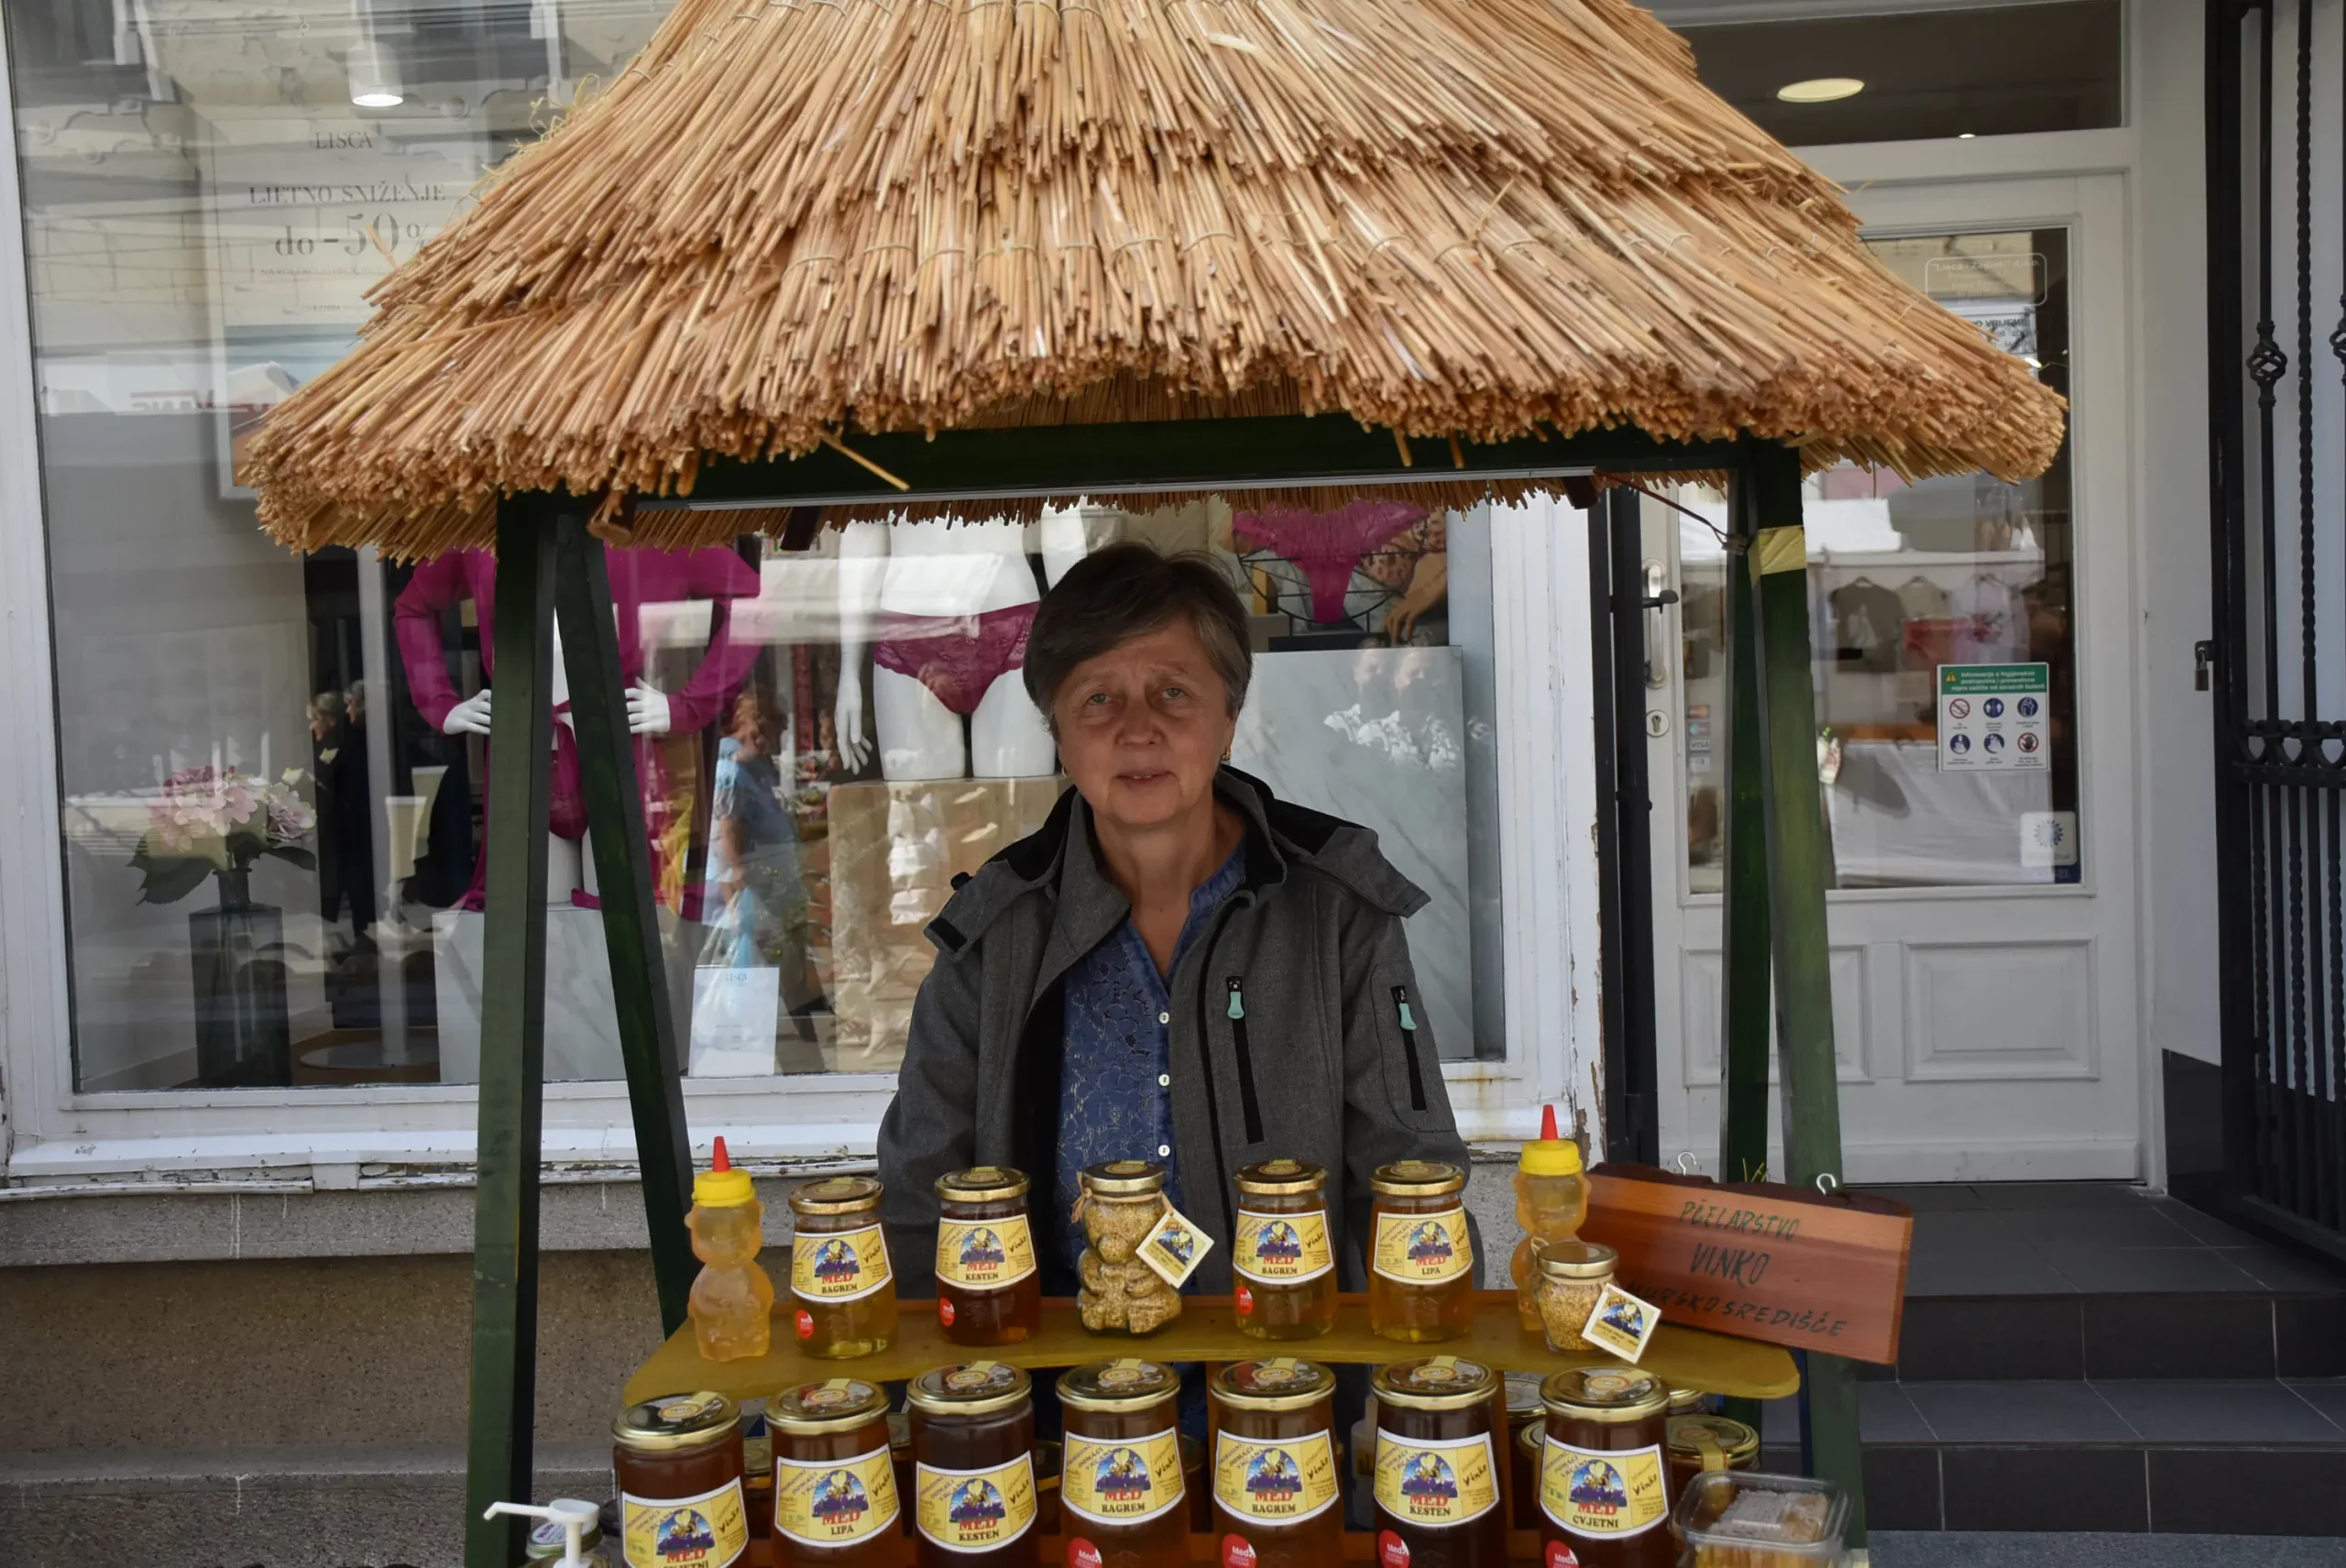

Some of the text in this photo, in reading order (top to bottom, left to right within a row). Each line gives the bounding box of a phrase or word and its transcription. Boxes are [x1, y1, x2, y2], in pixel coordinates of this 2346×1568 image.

[314, 131, 374, 149] LISCA
[248, 181, 446, 204] LJETNO SNIŽENJE
[275, 225, 314, 256] do
[1678, 1199, 1803, 1240] PČELARSTVO
[967, 1260, 998, 1271] MED
[1264, 1254, 1294, 1265] MED
[1416, 1255, 1446, 1266] MED
[1690, 1242, 1770, 1288] VINKO
[821, 1271, 854, 1284] MED
[965, 1272, 999, 1280] KESTEN
[1262, 1266, 1298, 1275] BAGREM
[821, 1283, 858, 1294] BAGREM
[1104, 1486, 1143, 1501] MED
[1255, 1488, 1294, 1502] MED
[1409, 1492, 1449, 1507] MED
[1102, 1502, 1146, 1513] BAGREM
[1252, 1503, 1296, 1514] BAGREM
[1409, 1506, 1451, 1517] KESTEN
[1577, 1500, 1618, 1516] MED
[822, 1508, 861, 1526] MED
[959, 1517, 997, 1531] MED
[1573, 1515, 1619, 1529] CVJETNI
[831, 1526, 854, 1536] LIPA
[959, 1530, 1000, 1541] KESTEN
[667, 1546, 707, 1563] MED
